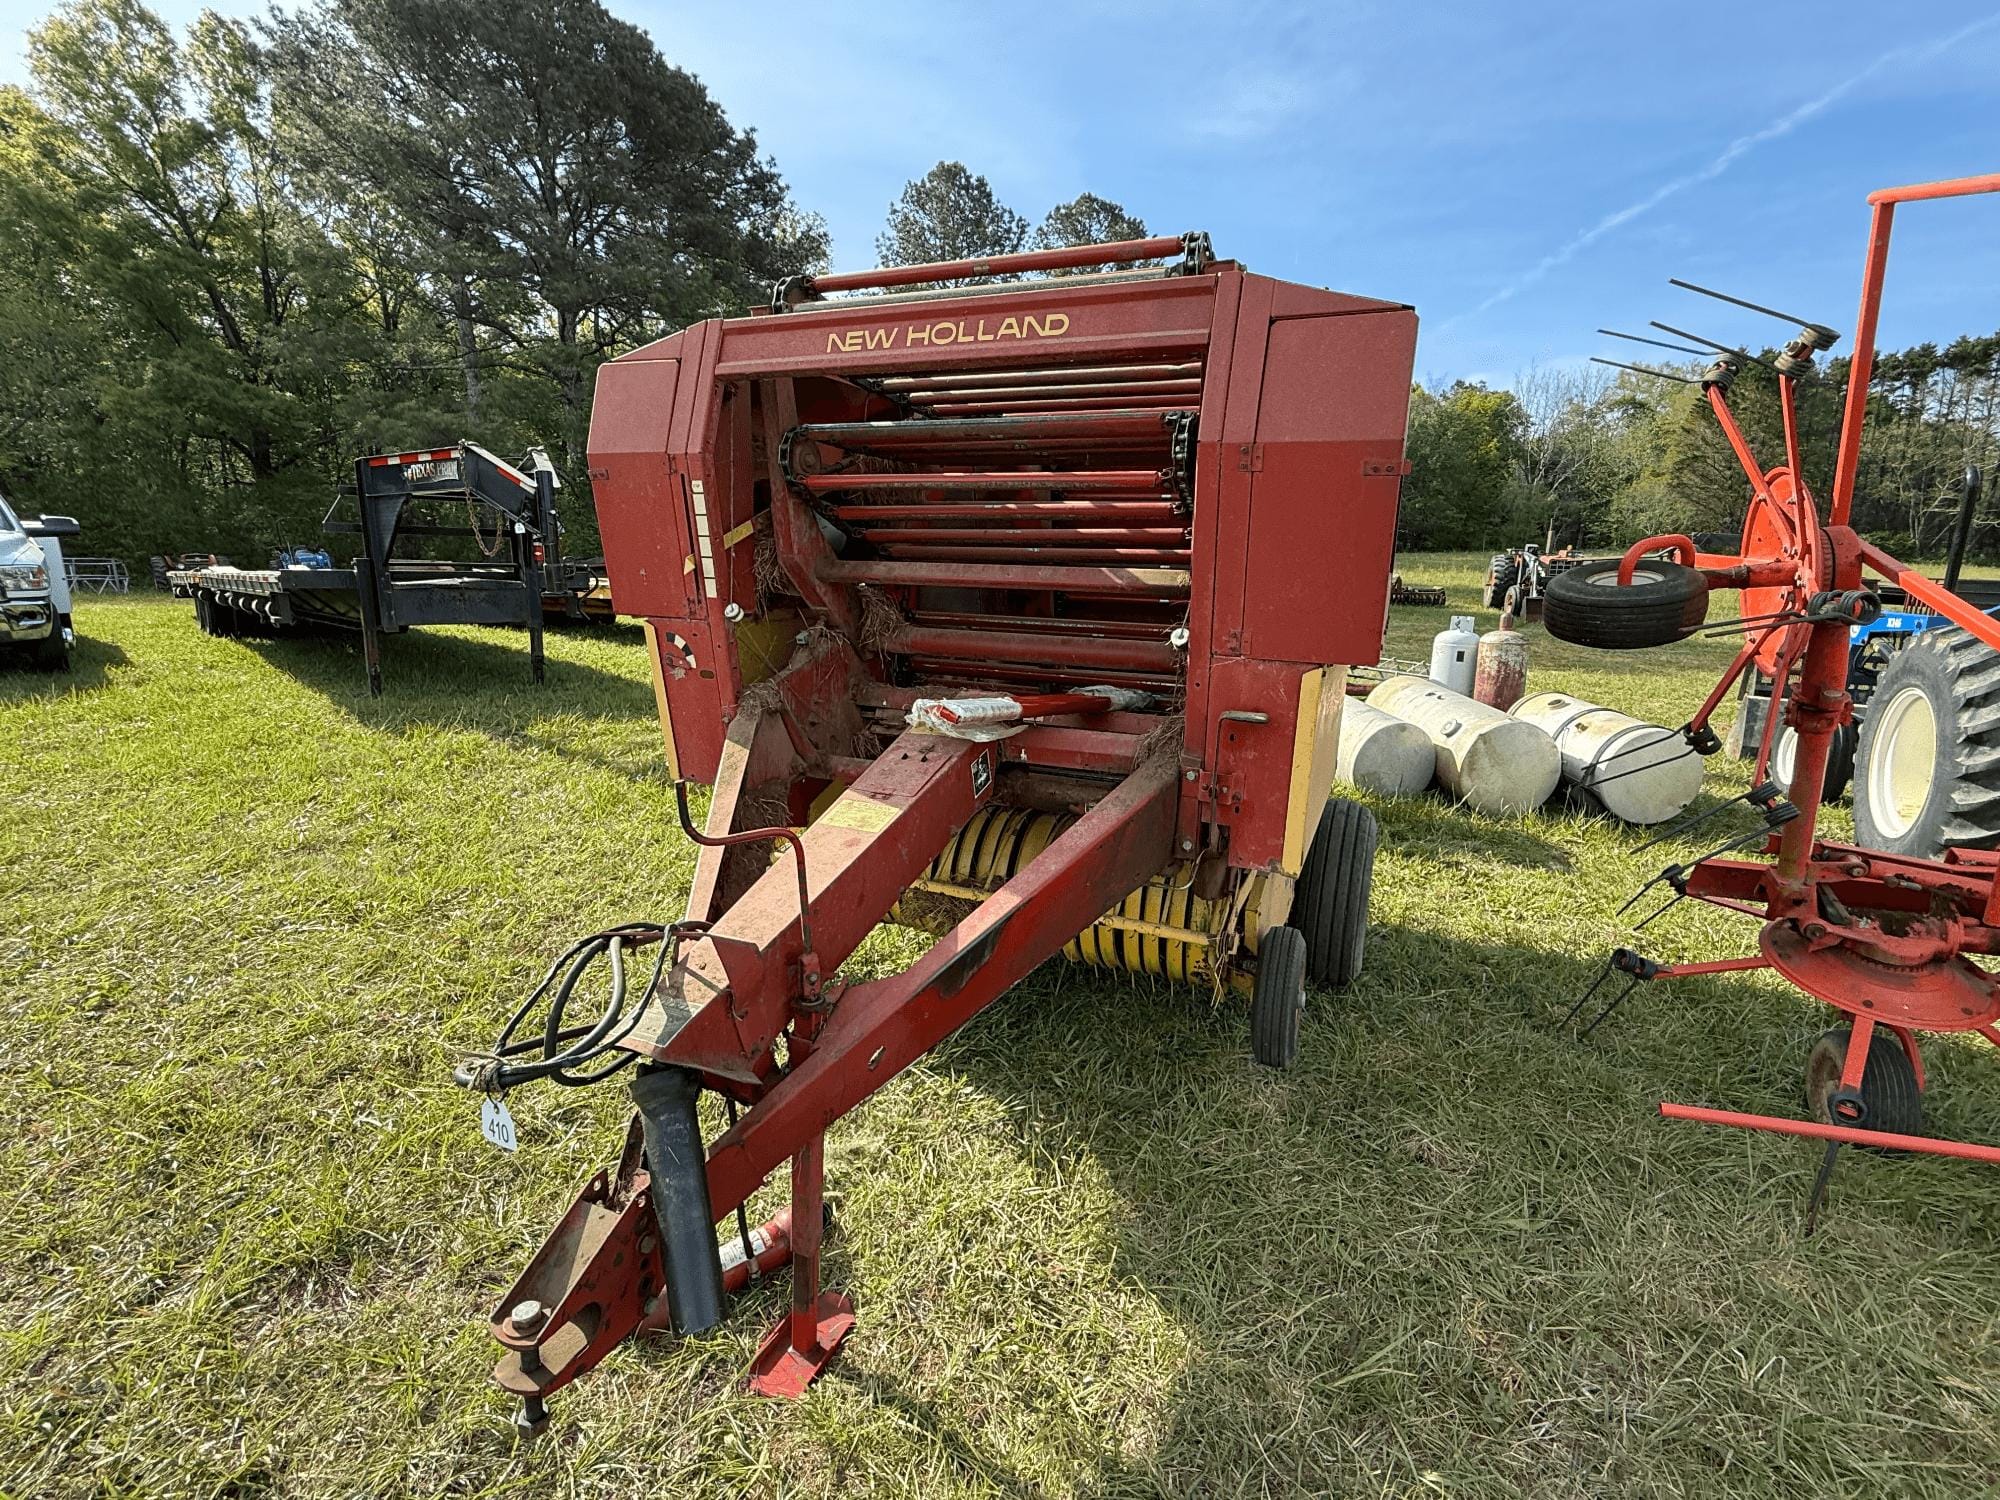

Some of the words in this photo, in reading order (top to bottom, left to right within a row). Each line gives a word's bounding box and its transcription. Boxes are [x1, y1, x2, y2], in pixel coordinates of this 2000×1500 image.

[826, 327, 898, 353] NEW
[906, 313, 1070, 346] HOLLAND
[410, 462, 435, 481] TEXAS
[488, 1118, 509, 1143] 410
